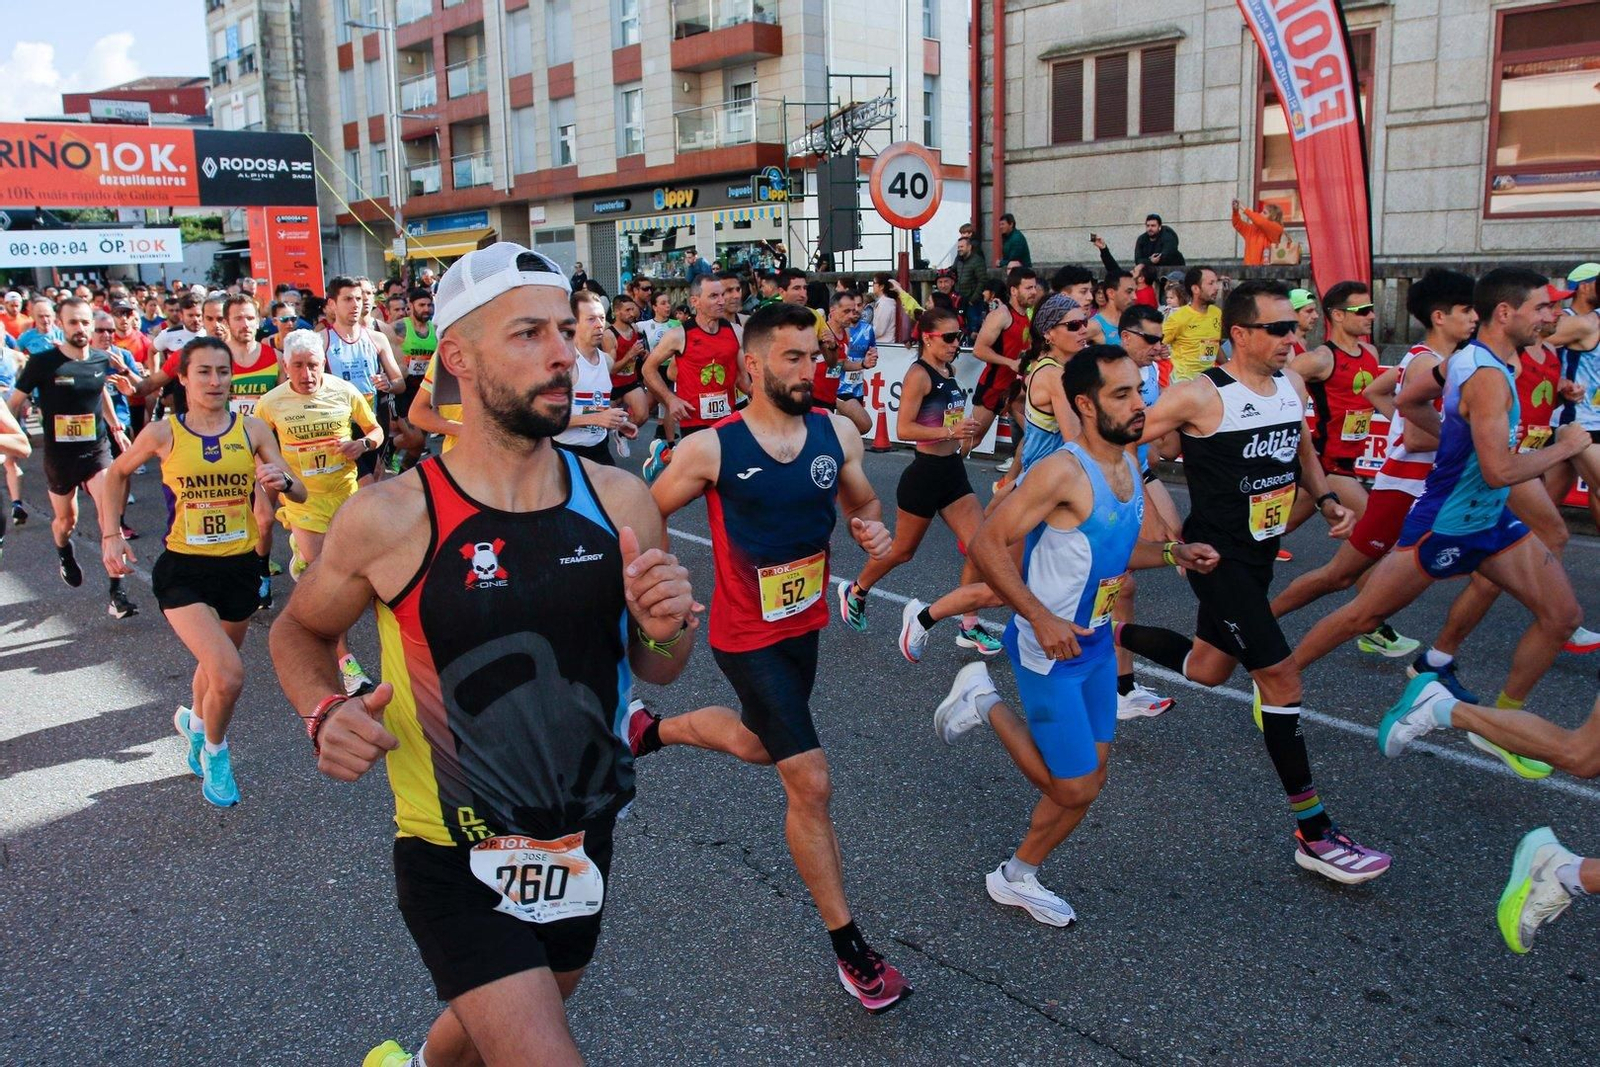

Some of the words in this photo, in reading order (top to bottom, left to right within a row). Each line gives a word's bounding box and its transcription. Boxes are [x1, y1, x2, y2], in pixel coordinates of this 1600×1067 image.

[219, 157, 289, 171] RODOSA
[888, 172, 928, 199] 40
[653, 187, 694, 210] Bippy
[10, 242, 88, 255] 00:00:04
[708, 401, 725, 414] 103
[67, 425, 81, 436] 80
[286, 420, 342, 434] ATHLETICS
[315, 454, 327, 468] 17
[176, 473, 248, 488] TANINOS
[181, 487, 248, 500] PONTEAREAS
[1264, 505, 1281, 528] 55
[203, 515, 226, 535] 68
[559, 553, 603, 565] TEAMERGY
[782, 577, 805, 606] 52
[496, 864, 570, 906] 760
